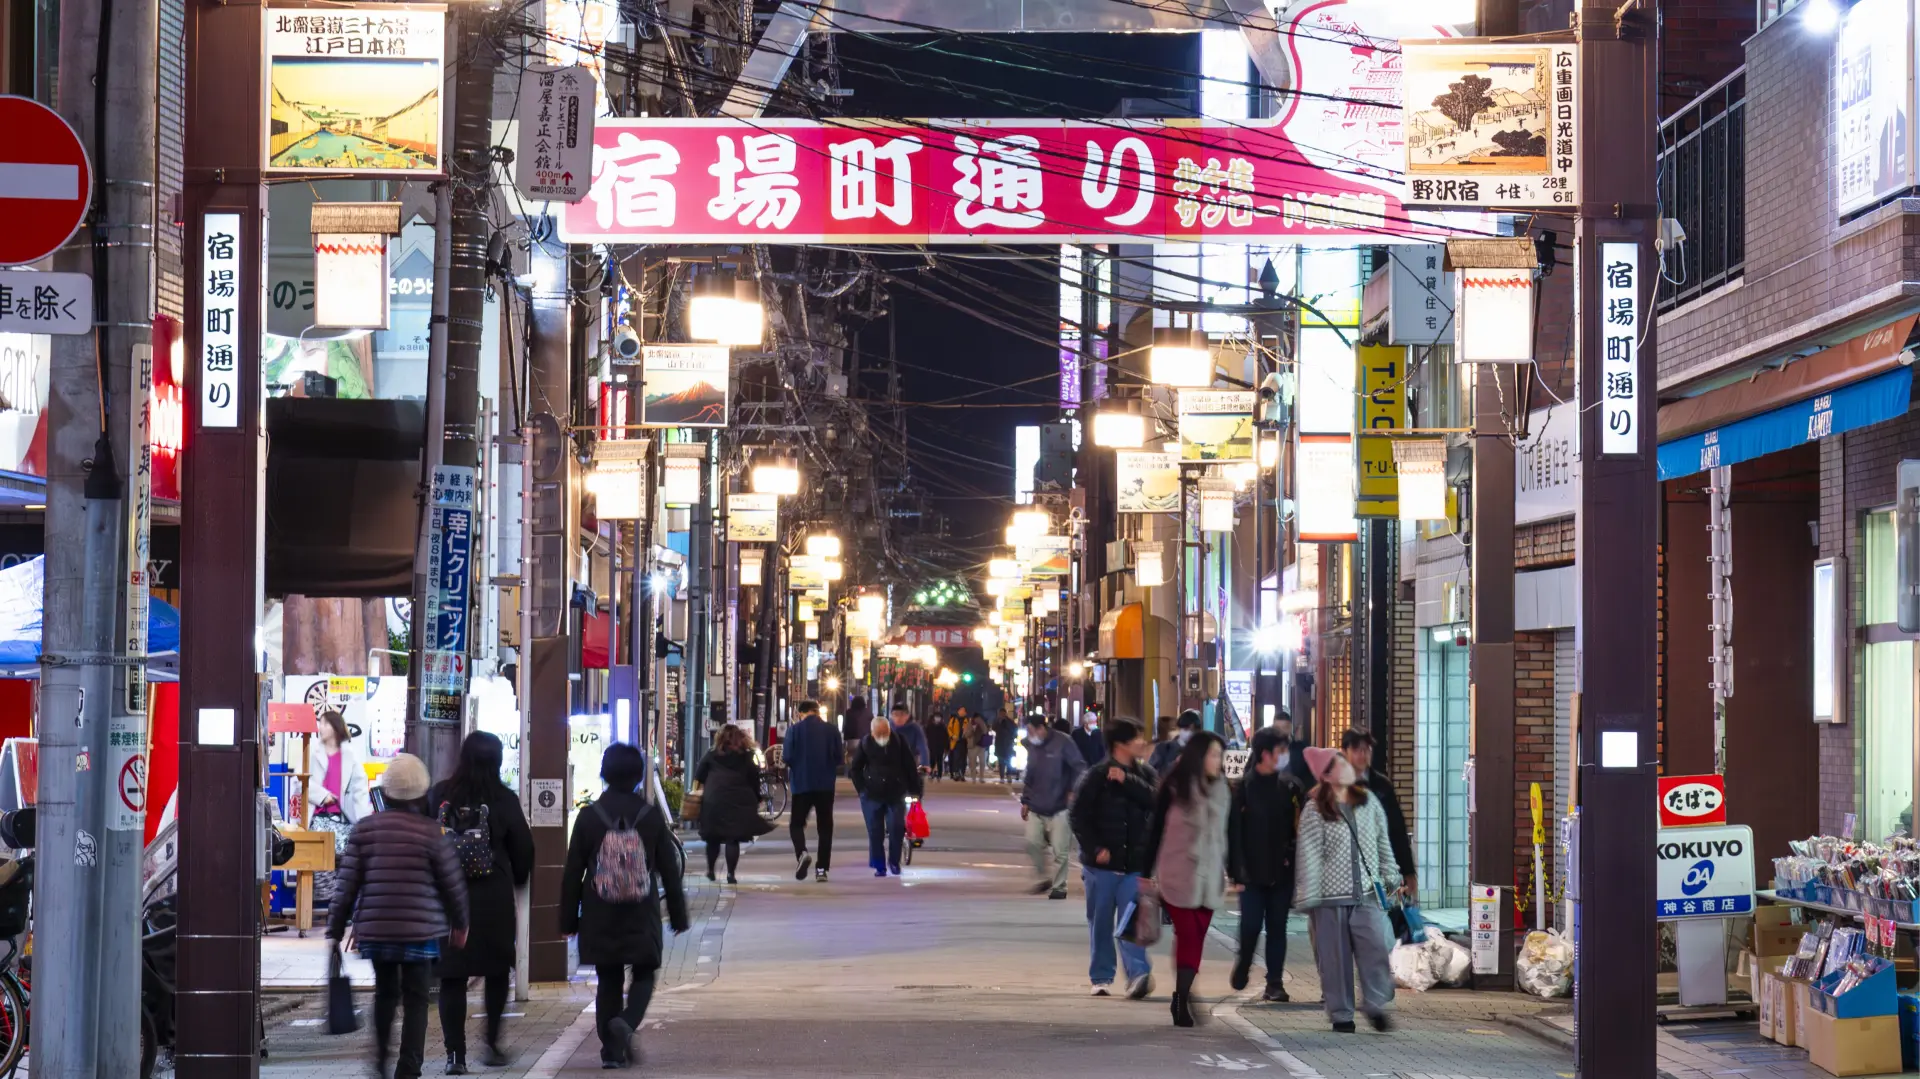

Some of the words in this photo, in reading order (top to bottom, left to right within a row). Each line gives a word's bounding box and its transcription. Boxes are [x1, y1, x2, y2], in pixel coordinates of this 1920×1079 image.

[305, 36, 406, 55] 江戸日本橋
[1556, 51, 1574, 173] 広重画日光道中
[555, 94, 568, 170] セレモニーホール
[536, 171, 561, 179] 400m
[588, 132, 1156, 230] 宿場町通り
[1174, 157, 1255, 194] 北千住
[1542, 177, 1568, 189] 28里
[1412, 179, 1480, 201] 野沢宿
[1552, 191, 1574, 203] 6町
[207, 232, 235, 408] 宿場町通り
[1607, 261, 1634, 436] 宿場町通り
[434, 472, 473, 488] 神経科
[433, 488, 473, 503] 心療内科
[444, 512, 468, 649] 幸仁クリニック
[1669, 788, 1716, 811] たばこ
[1656, 839, 1743, 860] KOKUYO
[1663, 898, 1736, 915] 神谷商店
